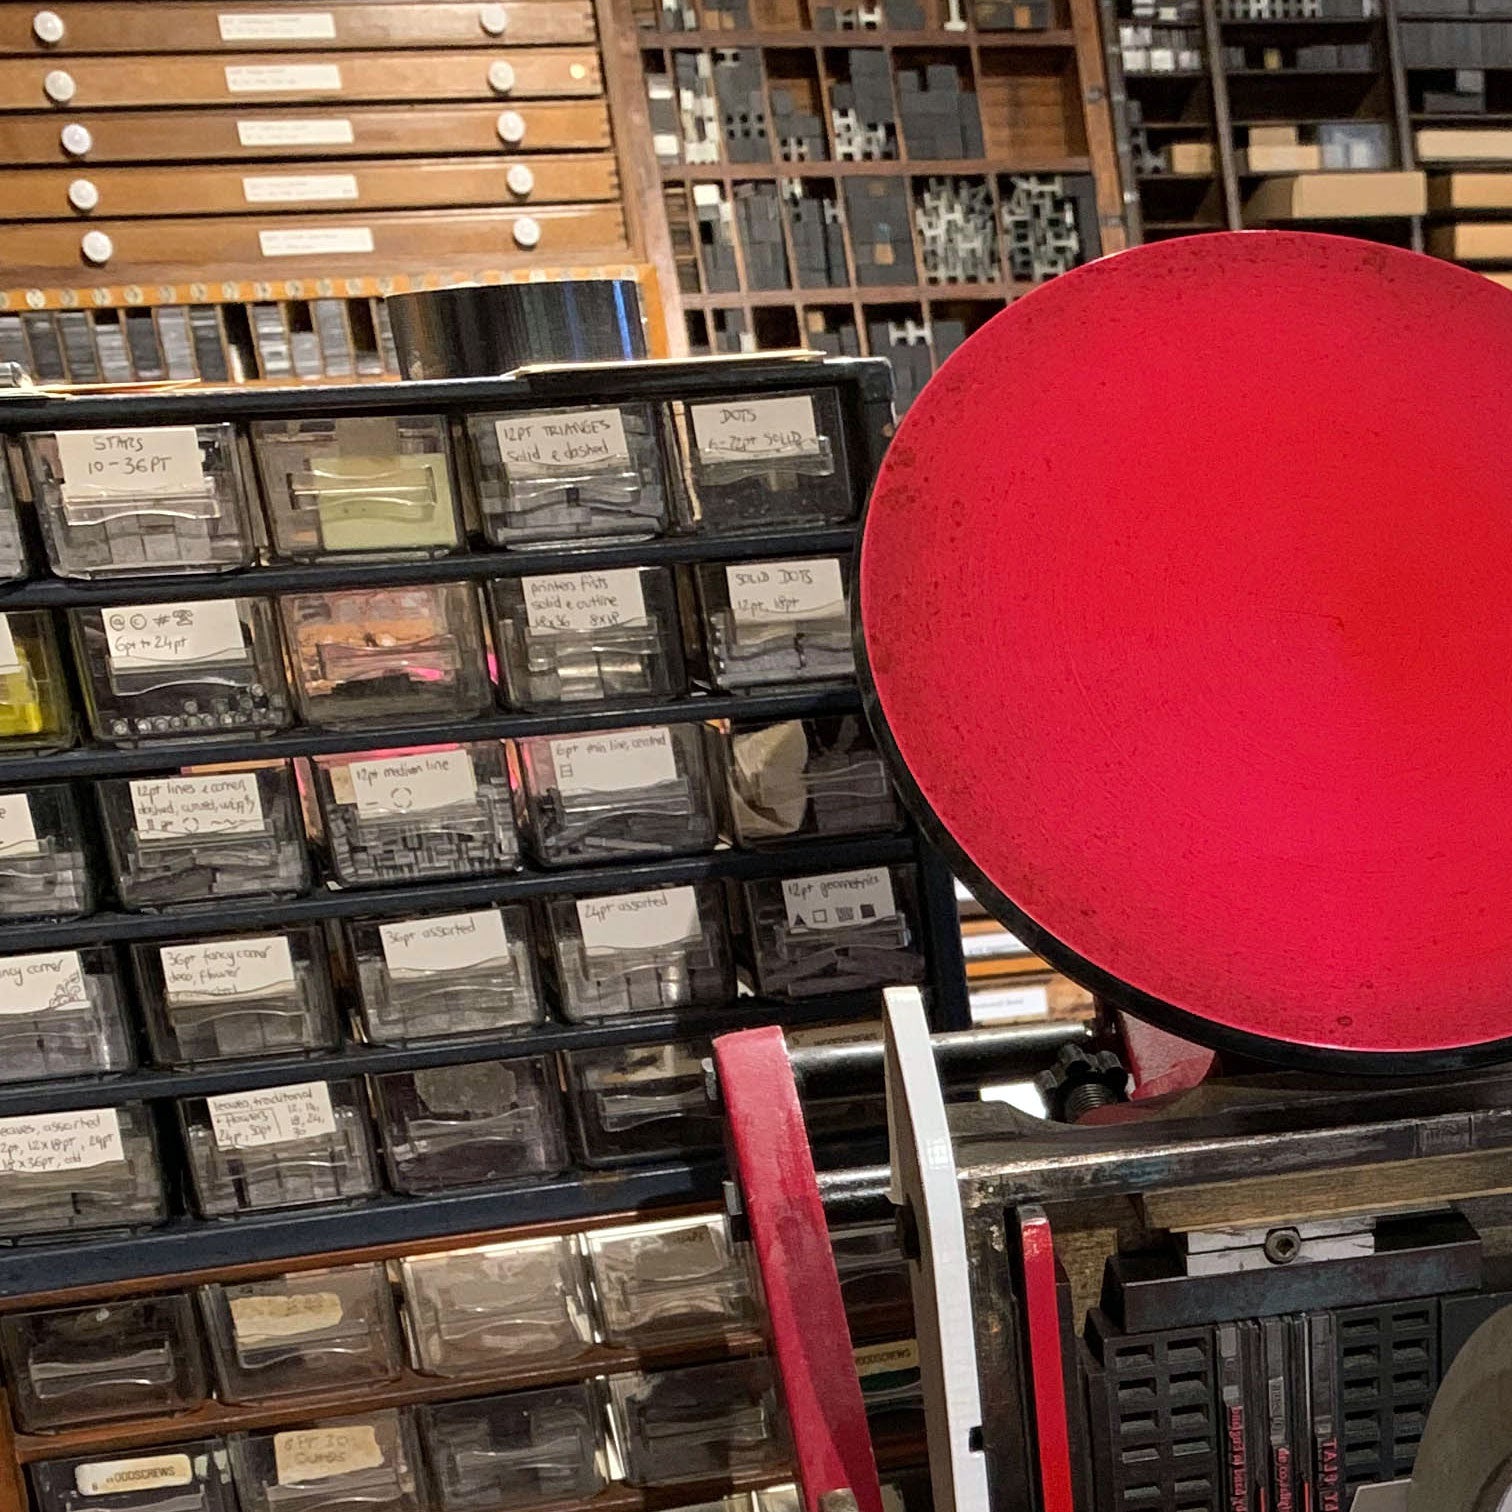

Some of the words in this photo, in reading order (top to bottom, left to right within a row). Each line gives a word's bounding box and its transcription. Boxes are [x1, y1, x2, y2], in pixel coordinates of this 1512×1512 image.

[92, 435, 144, 452] STARS
[777, 568, 814, 584] DOTS
[425, 759, 449, 771] line
[618, 891, 668, 911] assorted
[421, 916, 476, 937] assorted
